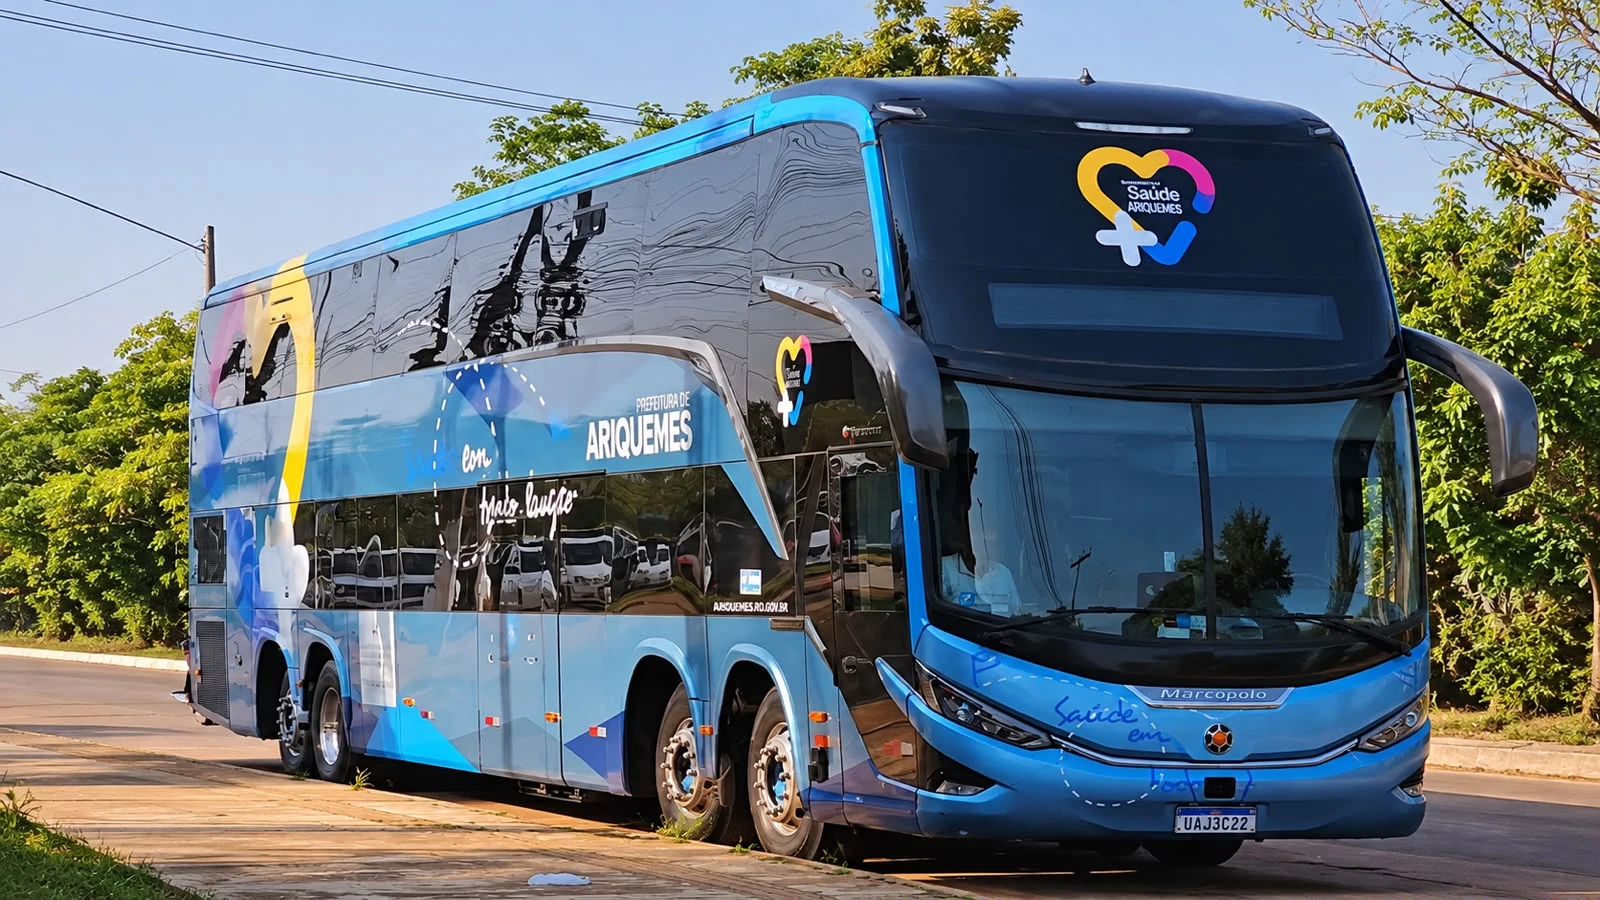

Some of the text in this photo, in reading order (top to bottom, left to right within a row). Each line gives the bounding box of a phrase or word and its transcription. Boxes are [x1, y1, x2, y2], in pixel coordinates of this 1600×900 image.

[1127, 185, 1180, 202] Saúde
[1127, 201, 1183, 215] ARIQUEMES
[636, 391, 691, 413] PREFEITURA DE
[585, 409, 693, 461] ARIQUEMES
[1160, 688, 1267, 702] Marcopolo
[1127, 728, 1171, 744] em
[1184, 816, 1249, 831] UAJ3C22
